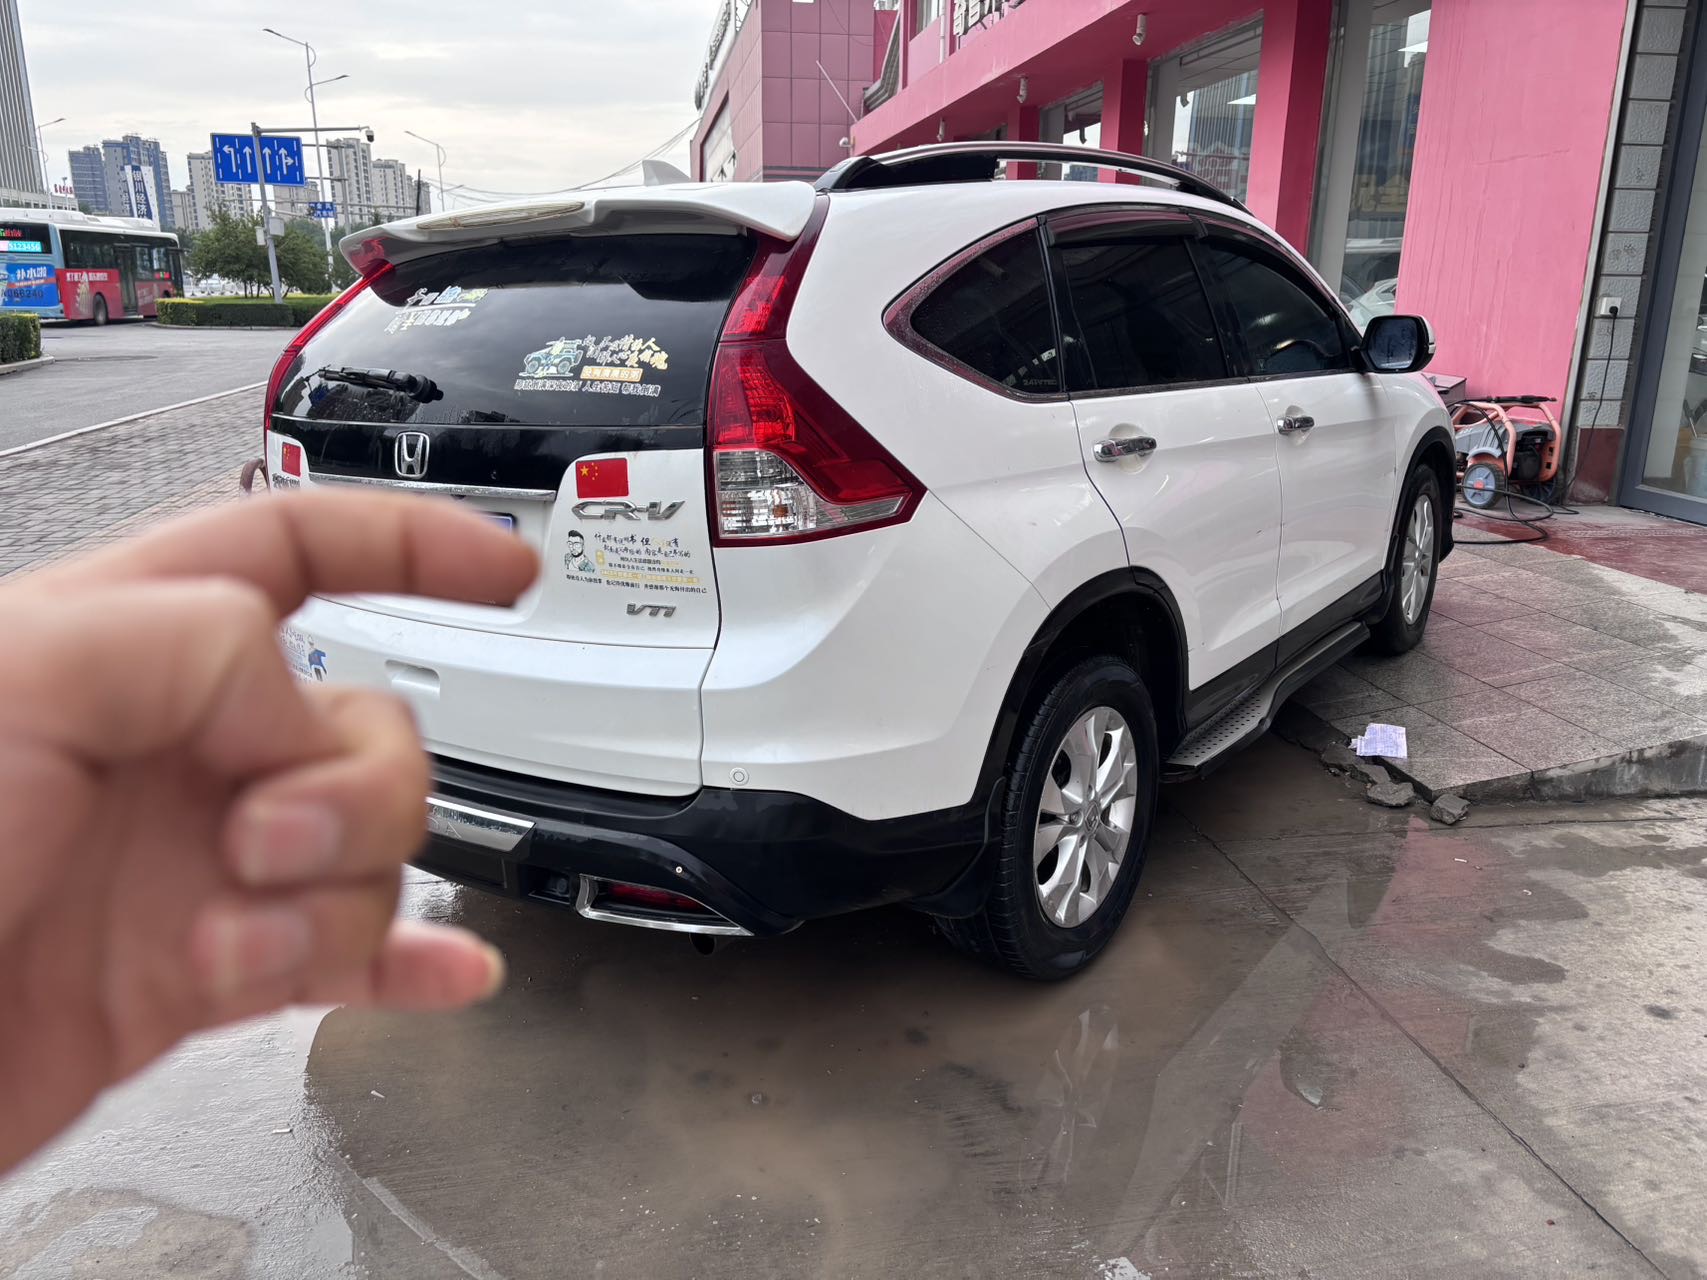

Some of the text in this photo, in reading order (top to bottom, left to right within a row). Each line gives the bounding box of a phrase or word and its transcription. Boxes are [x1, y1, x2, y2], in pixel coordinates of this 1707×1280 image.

[132, 170, 148, 218] 银川经济
[571, 500, 686, 521] CR-V
